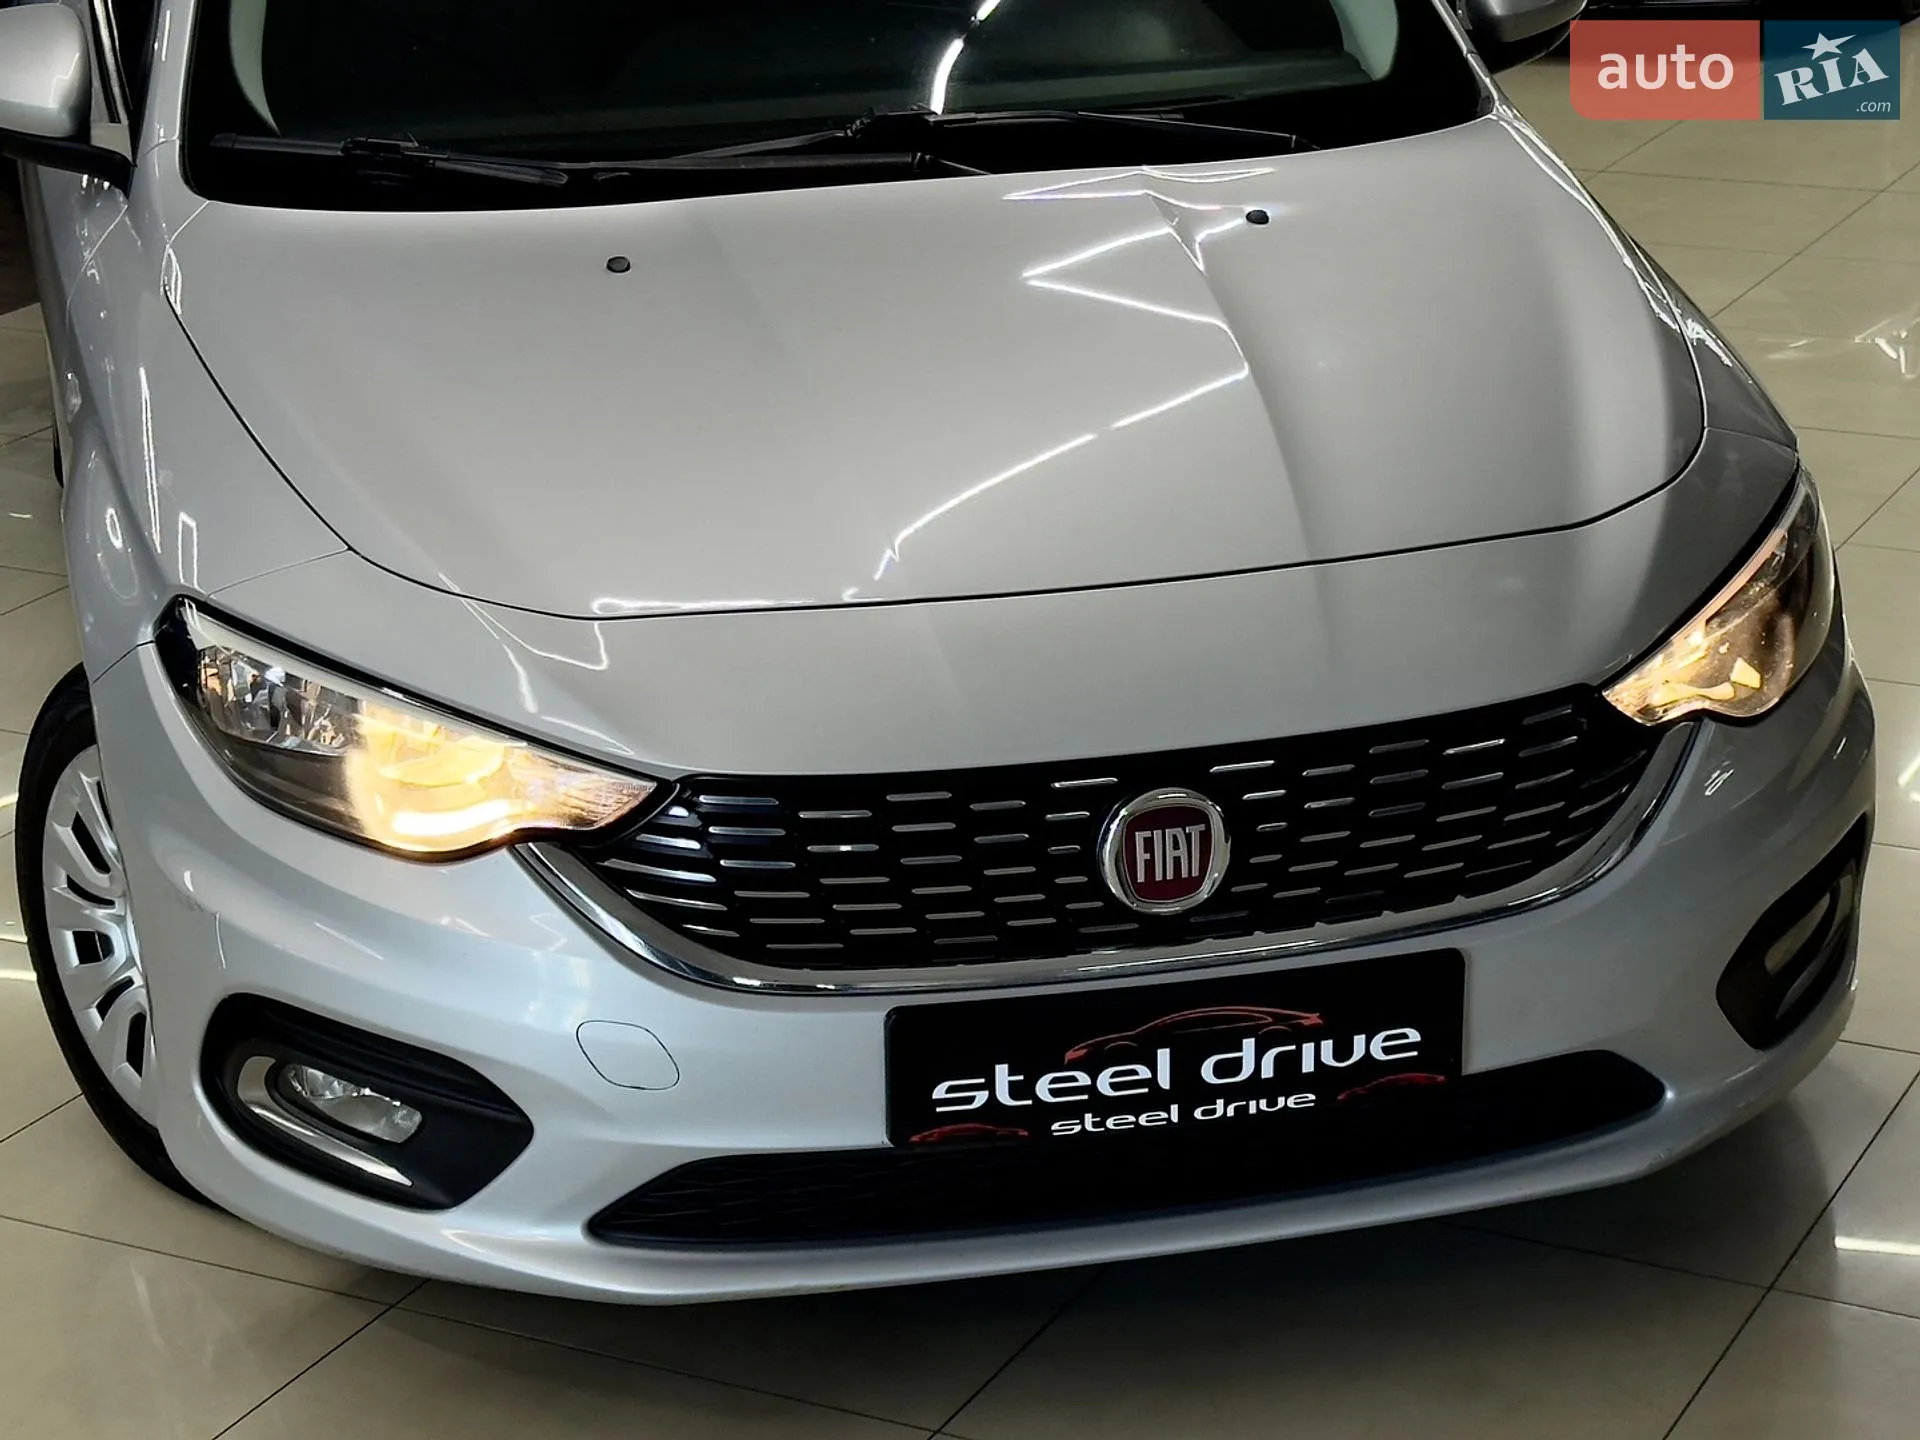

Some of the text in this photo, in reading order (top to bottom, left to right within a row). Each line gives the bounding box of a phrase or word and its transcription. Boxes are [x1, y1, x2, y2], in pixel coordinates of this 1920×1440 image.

[1135, 823, 1206, 883] FIAT
[932, 1027, 1422, 1113] steel drive
[1051, 1092, 1316, 1136] steel drive
